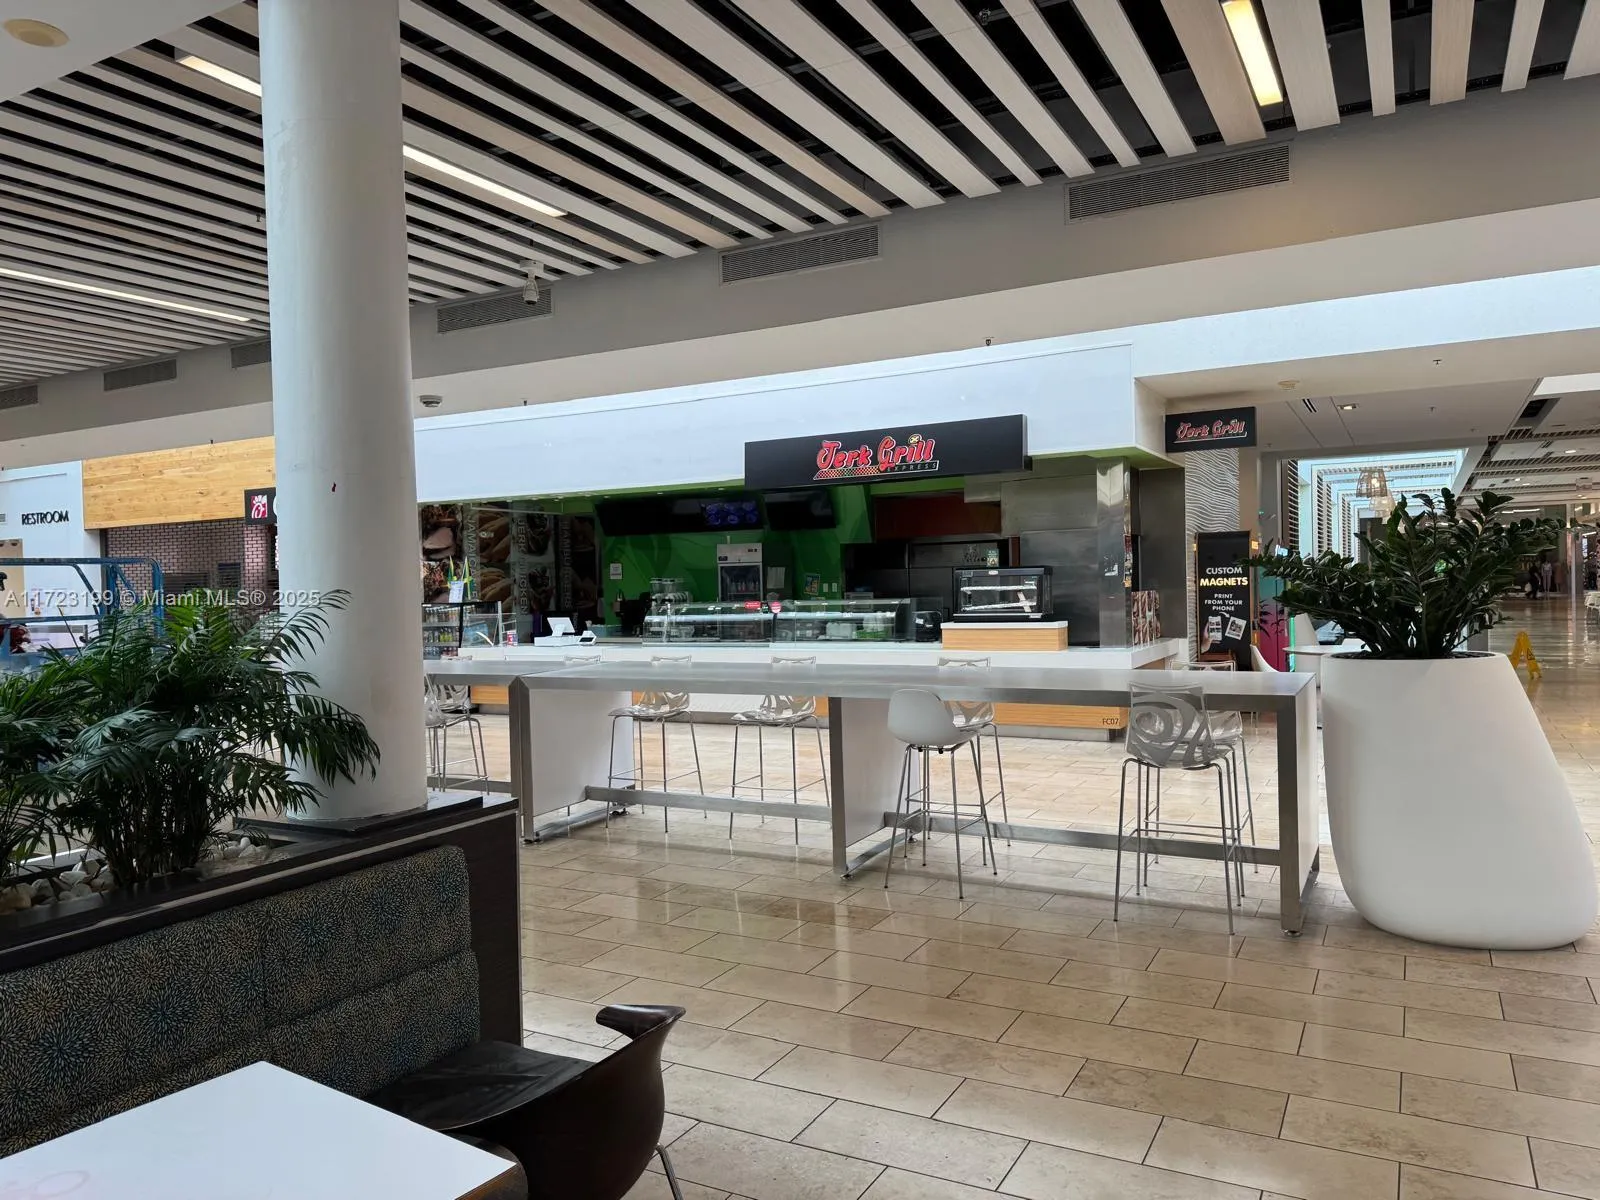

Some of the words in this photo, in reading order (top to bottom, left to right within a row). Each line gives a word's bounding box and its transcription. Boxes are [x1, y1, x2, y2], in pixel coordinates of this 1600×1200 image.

[816, 439, 873, 471] Jerk
[877, 433, 936, 472] Grill
[21, 510, 70, 525] RESTROOM
[1206, 567, 1243, 575] CUSTOM
[1200, 577, 1249, 587] MAGNETS
